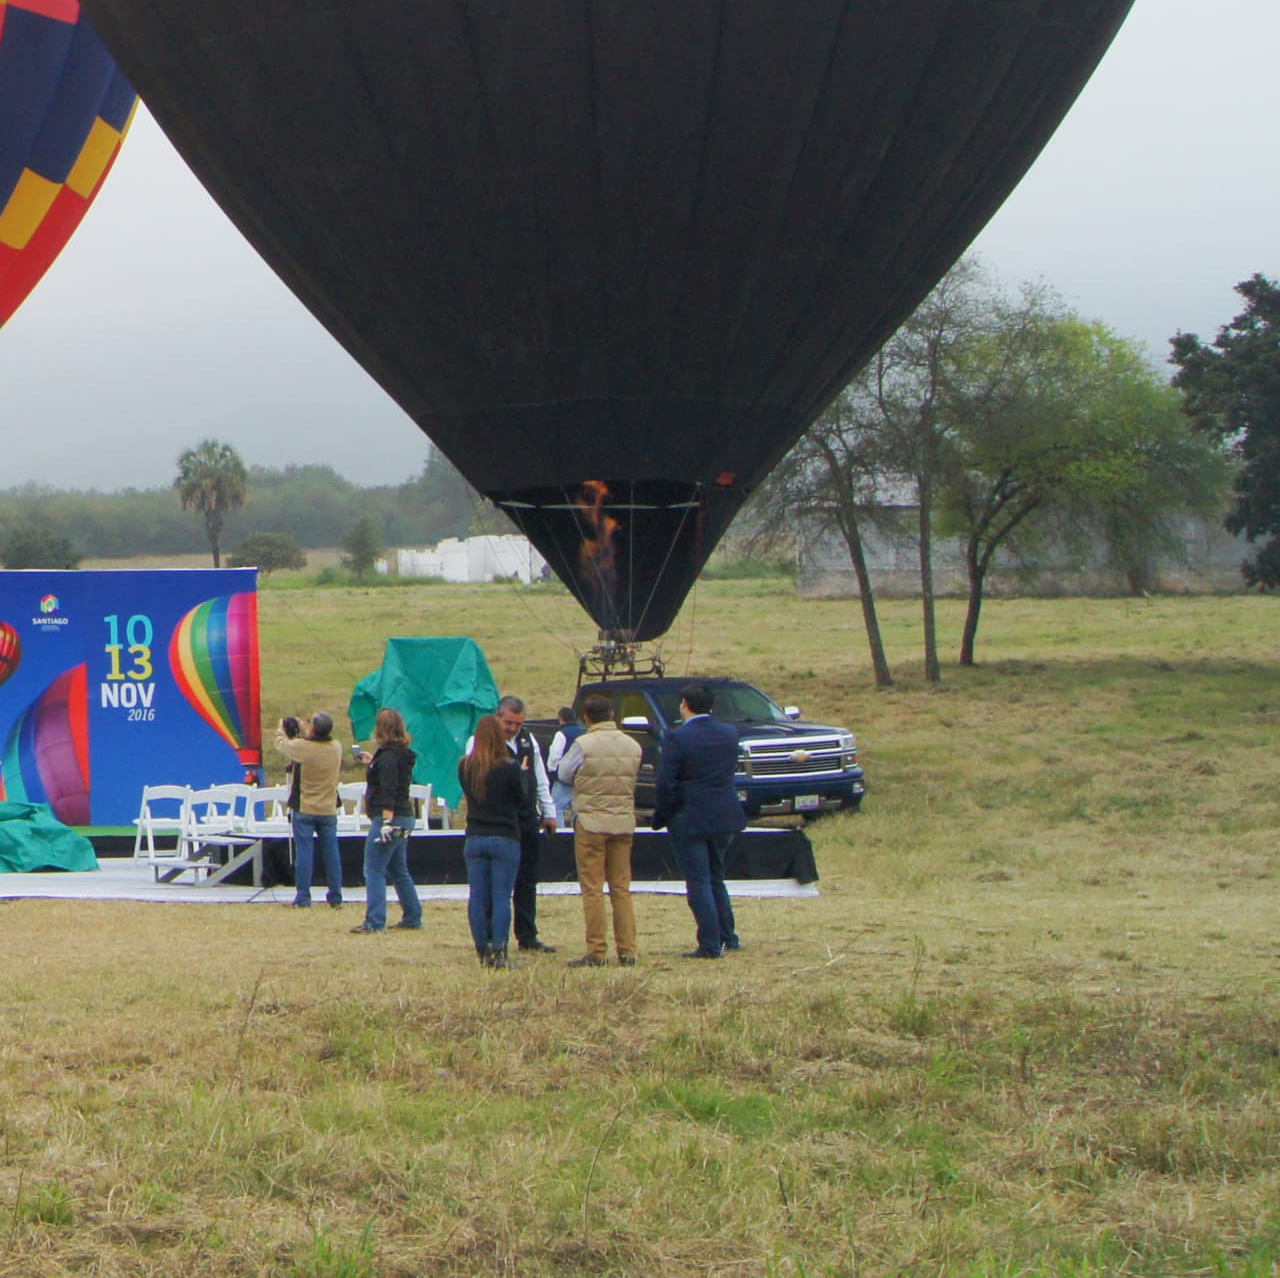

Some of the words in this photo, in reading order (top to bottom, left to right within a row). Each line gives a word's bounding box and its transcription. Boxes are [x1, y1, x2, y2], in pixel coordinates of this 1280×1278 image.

[32, 618, 69, 626] SANTIAGO
[103, 614, 154, 649] 10
[104, 643, 154, 680] 13
[100, 682, 156, 708] NOV
[127, 708, 156, 721] 2016
